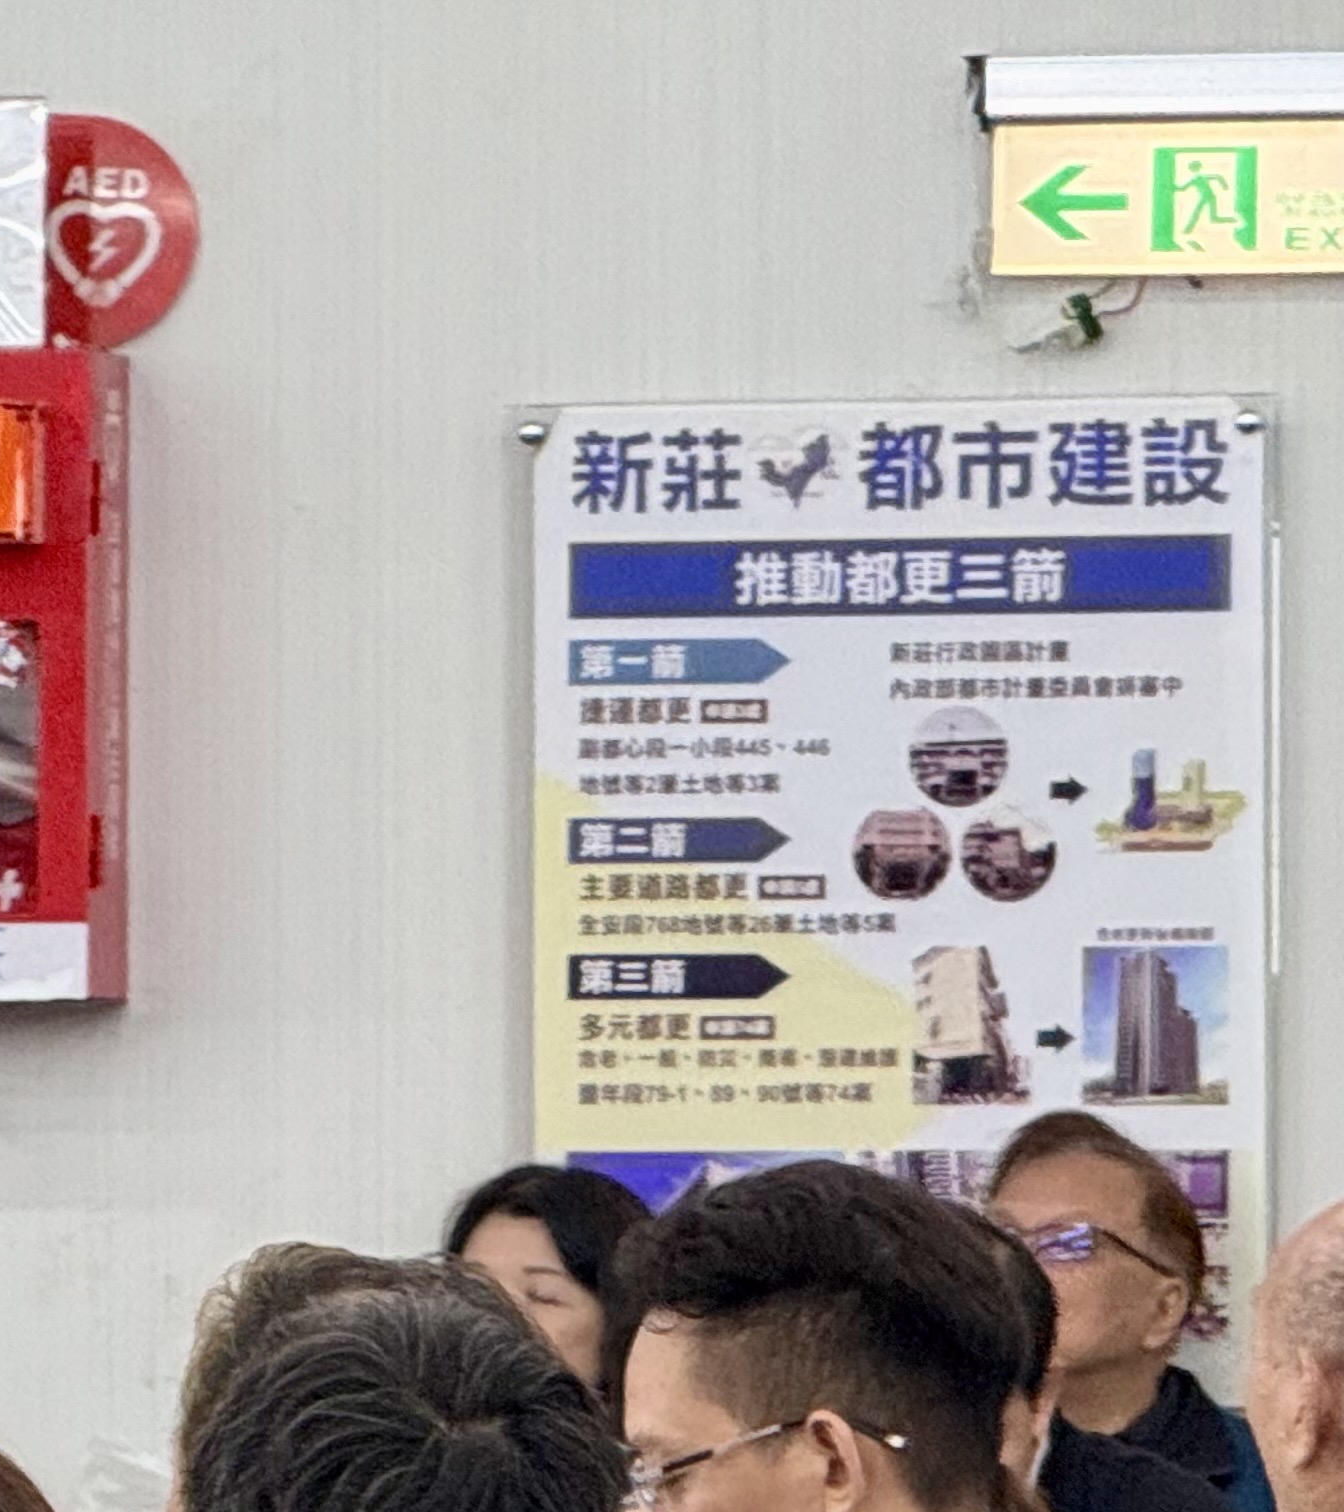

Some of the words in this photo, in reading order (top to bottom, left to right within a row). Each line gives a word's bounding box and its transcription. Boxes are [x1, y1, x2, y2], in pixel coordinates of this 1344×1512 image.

[62, 165, 150, 200] AED
[572, 429, 743, 514] 新莊
[858, 417, 1230, 512] 都市建設
[734, 550, 1066, 606] 推動都更三箭
[579, 644, 687, 679] 第一箭
[580, 697, 691, 724] 捷運都更
[579, 822, 688, 858] 第二箭
[579, 873, 748, 900] 主要道路都更
[579, 959, 688, 995] 第三箭
[578, 1013, 692, 1040] 多元都更
